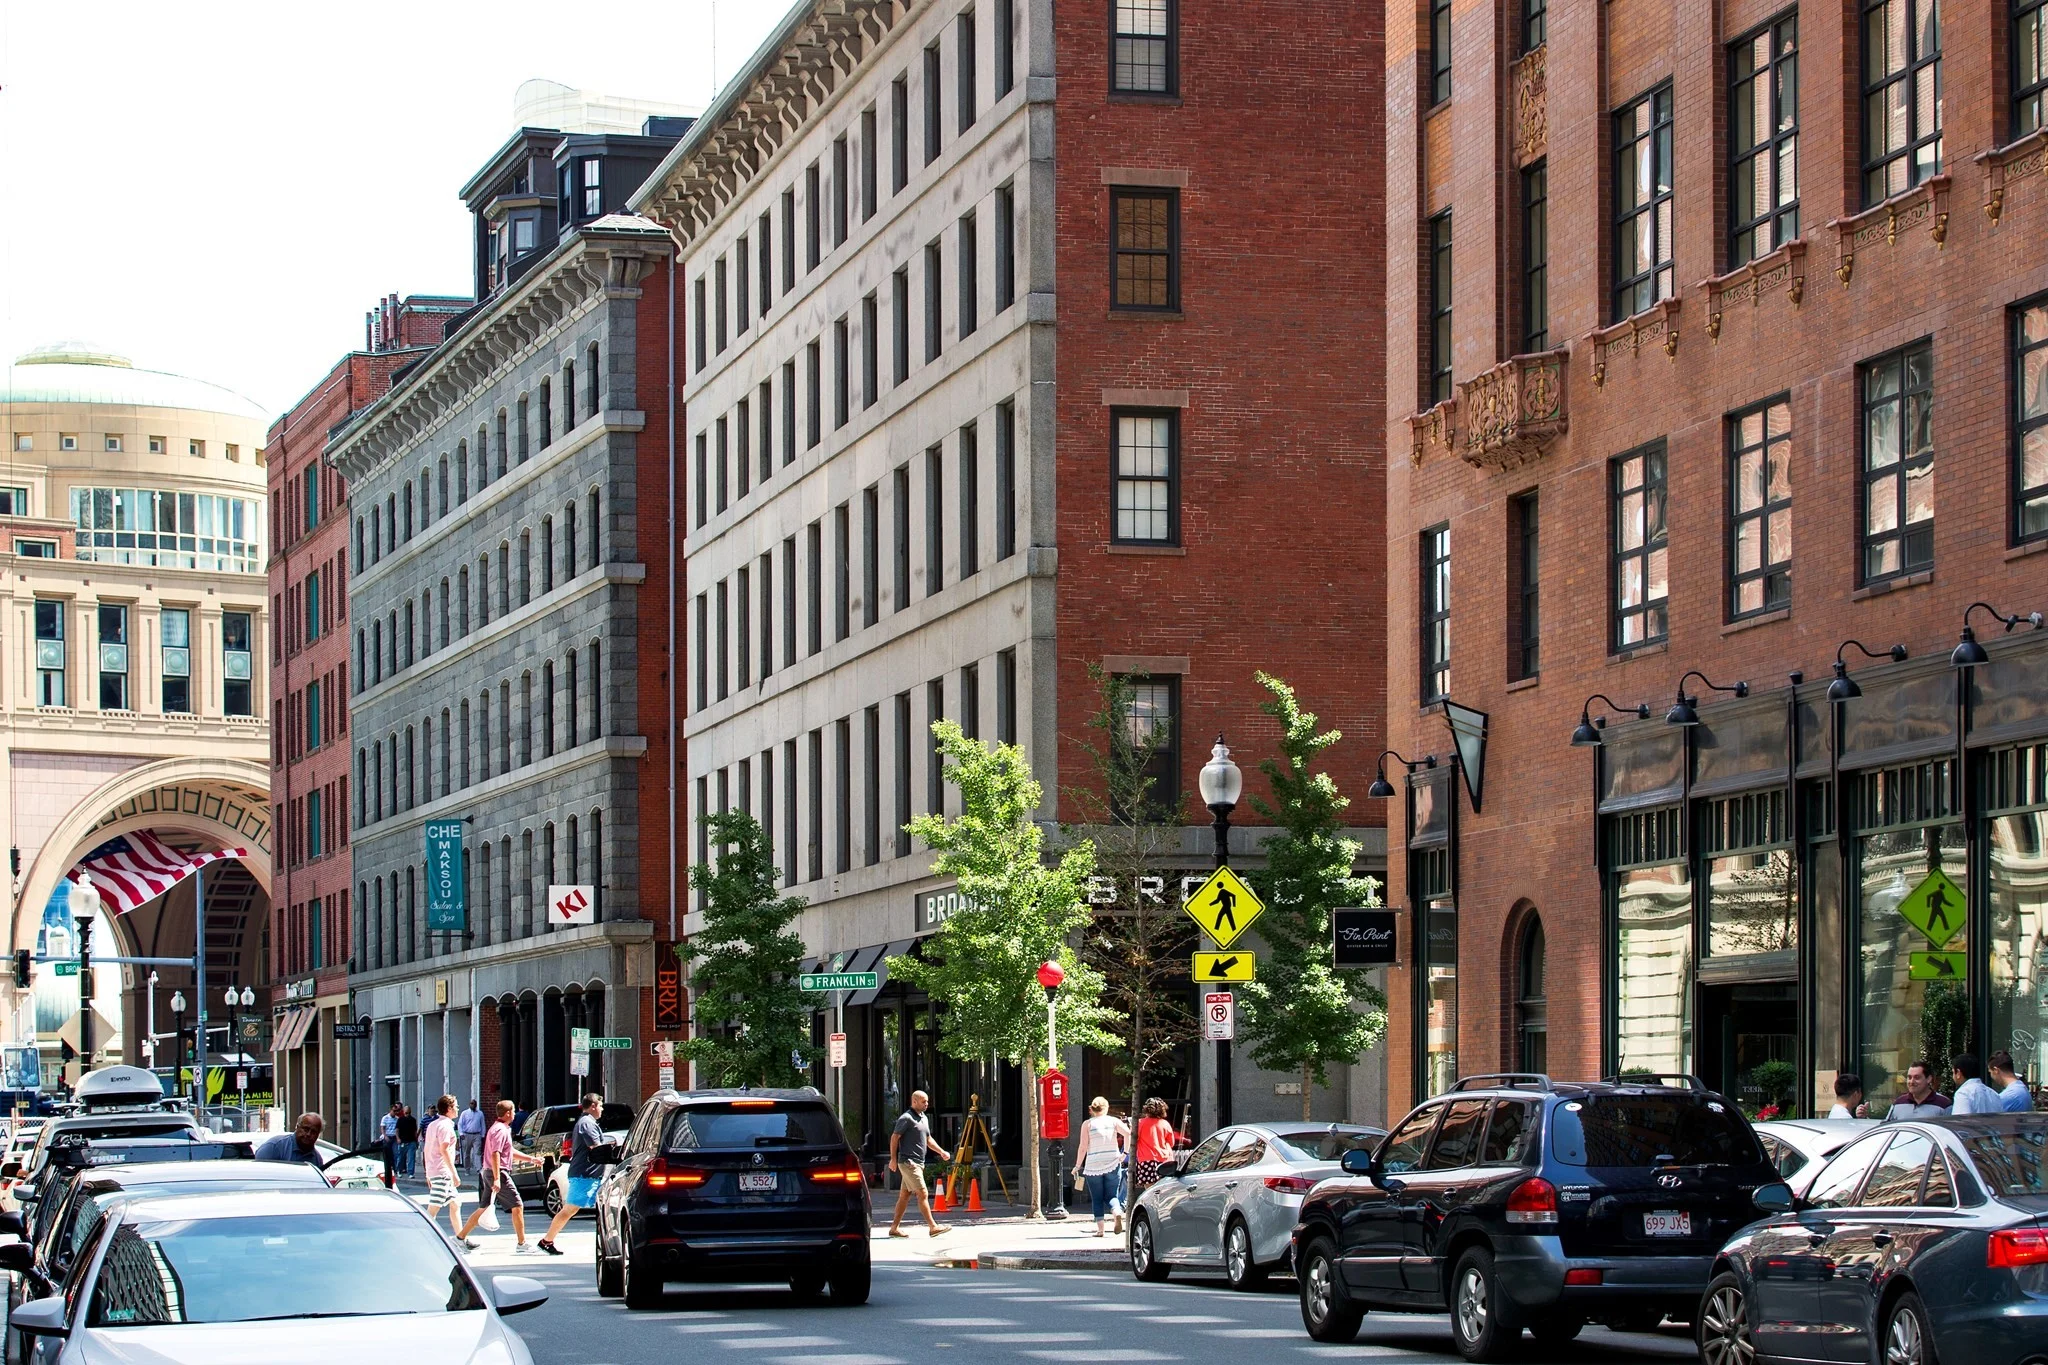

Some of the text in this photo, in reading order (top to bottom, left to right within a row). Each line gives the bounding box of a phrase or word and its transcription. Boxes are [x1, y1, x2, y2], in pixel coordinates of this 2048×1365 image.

[428, 825, 460, 838] CHE
[556, 888, 588, 920] KI
[1339, 927, 1392, 940] Fin Point
[816, 976, 866, 988] FRANKLIN
[659, 971, 677, 1017] BRIX
[752, 1176, 775, 1187] 5527
[1646, 1216, 1689, 1230] 699 JX5
